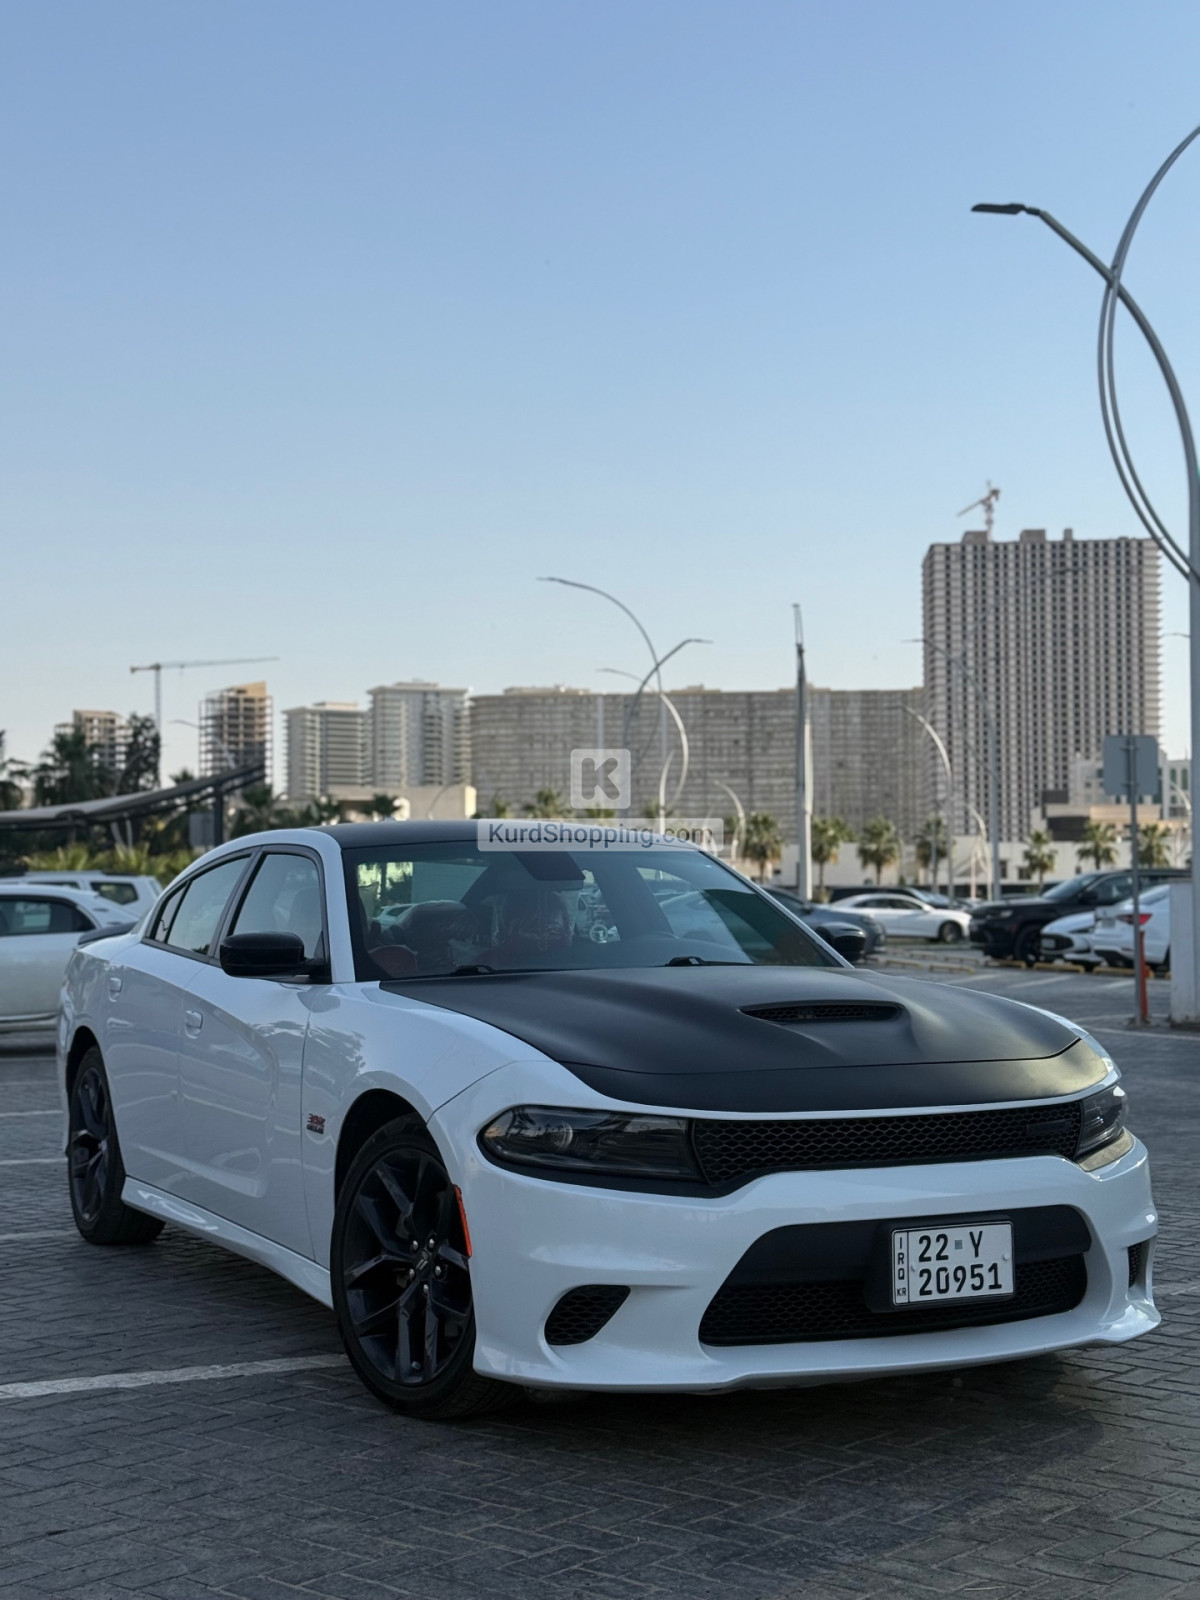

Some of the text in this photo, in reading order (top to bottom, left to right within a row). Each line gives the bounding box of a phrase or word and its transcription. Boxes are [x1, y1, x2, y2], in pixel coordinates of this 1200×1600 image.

[918, 1230, 983, 1262] 22 Y
[896, 1287, 907, 1296] KR
[918, 1262, 1002, 1296] 20951
